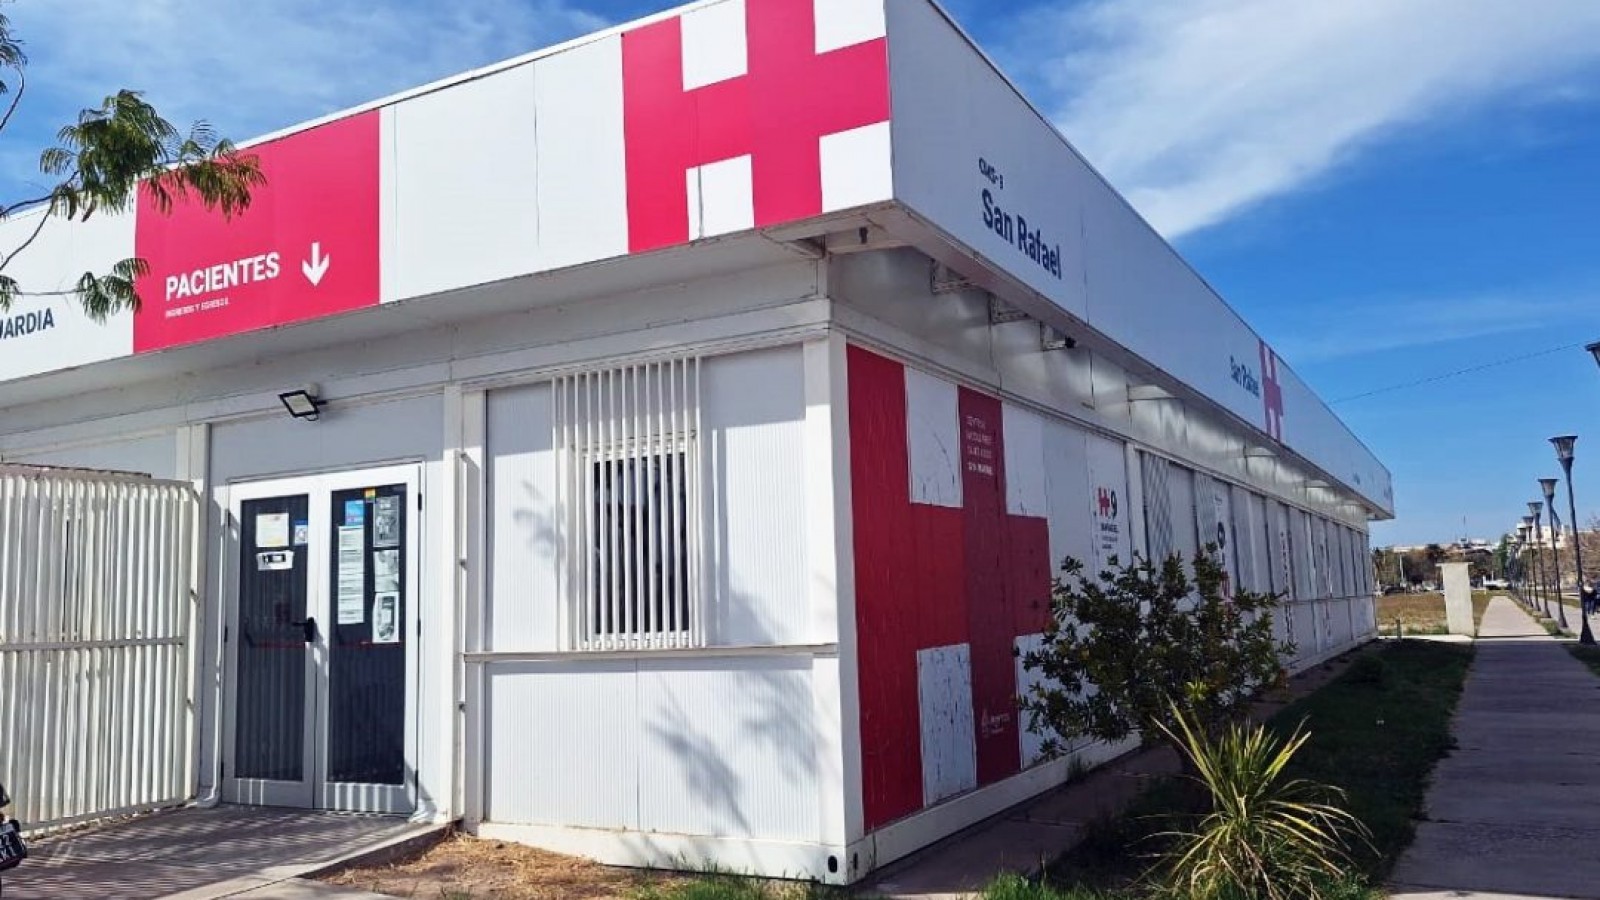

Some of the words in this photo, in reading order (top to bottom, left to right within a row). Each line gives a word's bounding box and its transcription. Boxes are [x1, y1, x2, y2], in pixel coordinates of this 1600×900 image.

[982, 188, 1014, 245] San
[1017, 214, 1062, 280] Rafael
[165, 252, 281, 301] PACIENTES
[0, 307, 55, 340] ARDIA
